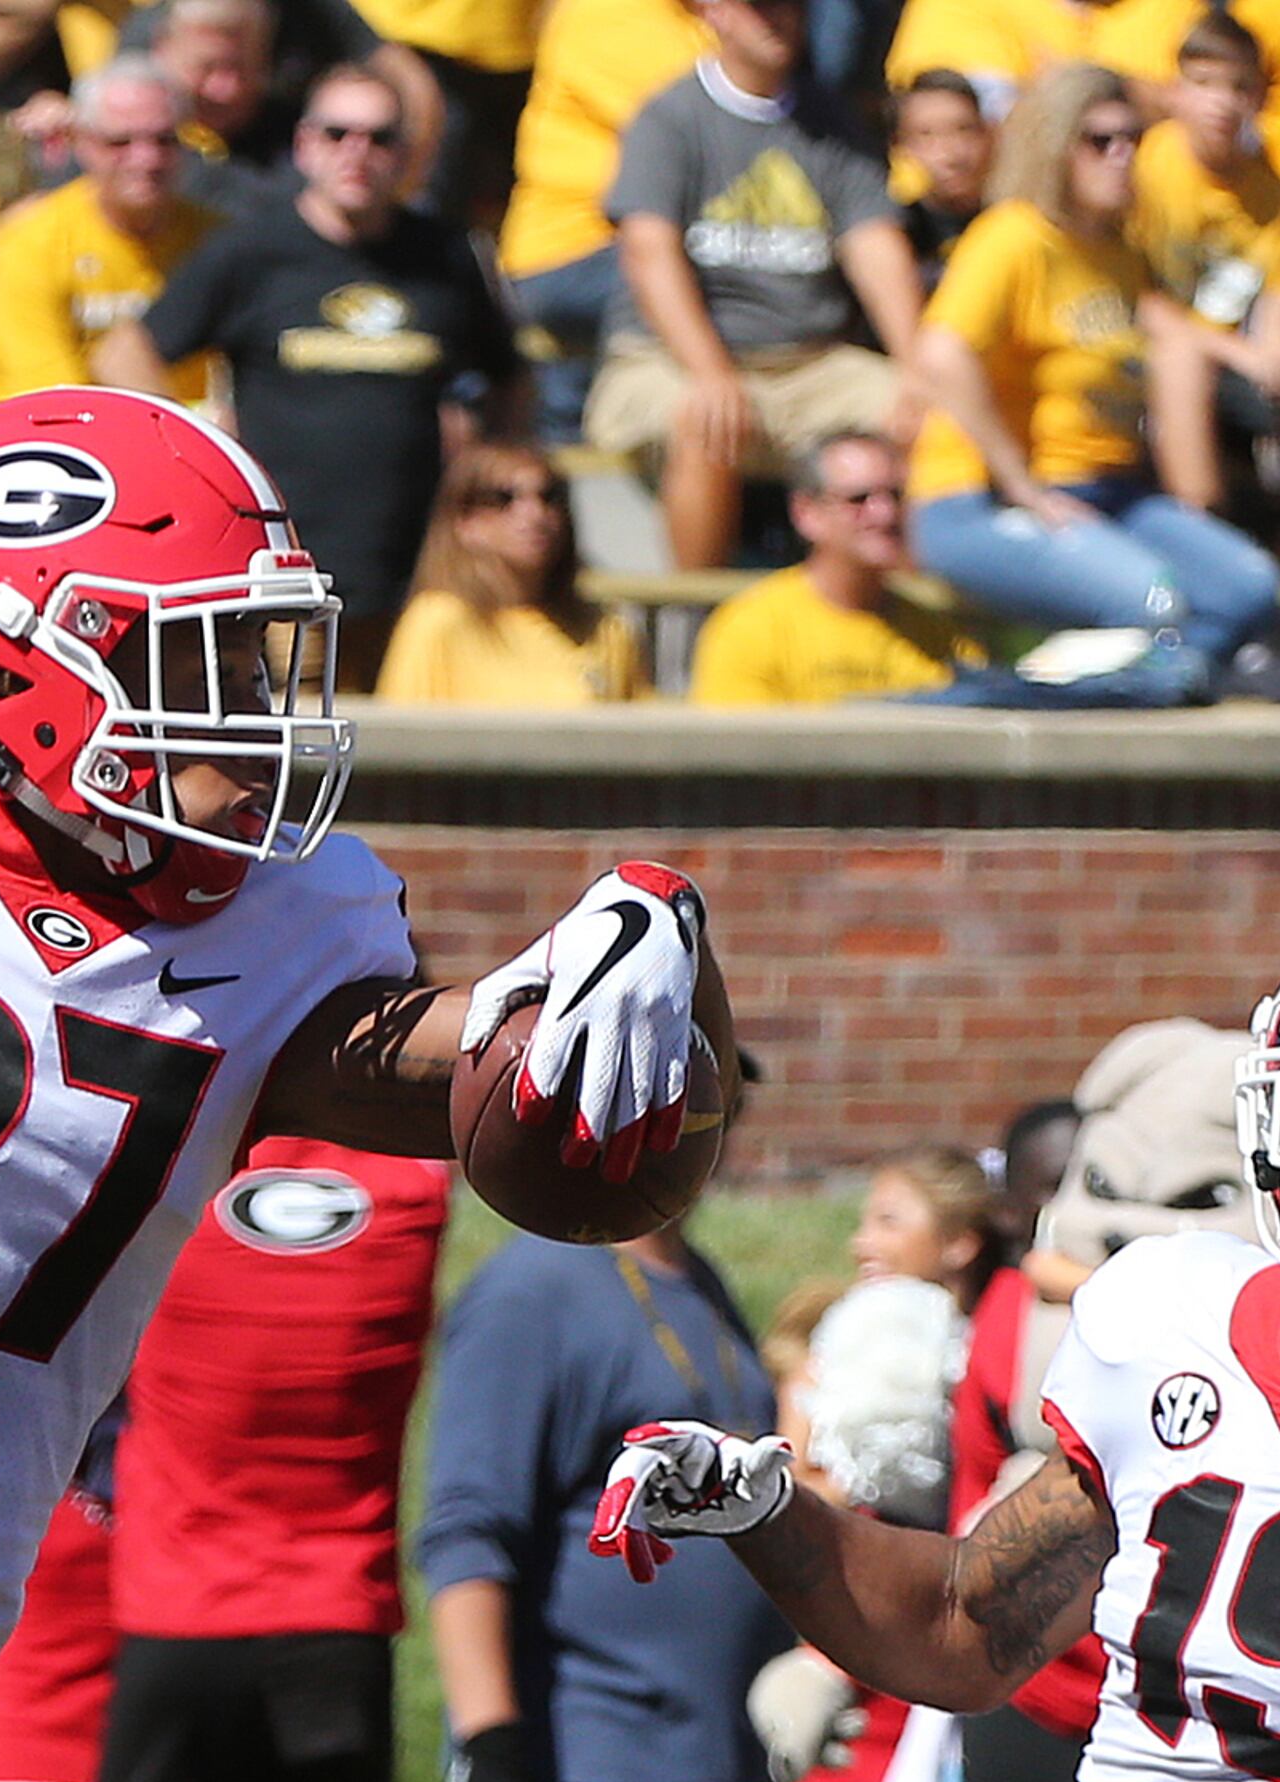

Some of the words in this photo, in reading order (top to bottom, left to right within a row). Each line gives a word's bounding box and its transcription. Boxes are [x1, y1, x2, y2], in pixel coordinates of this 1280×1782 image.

[31, 912, 86, 948] G
[232, 1179, 356, 1242] G
[1153, 1373, 1219, 1446] SEC
